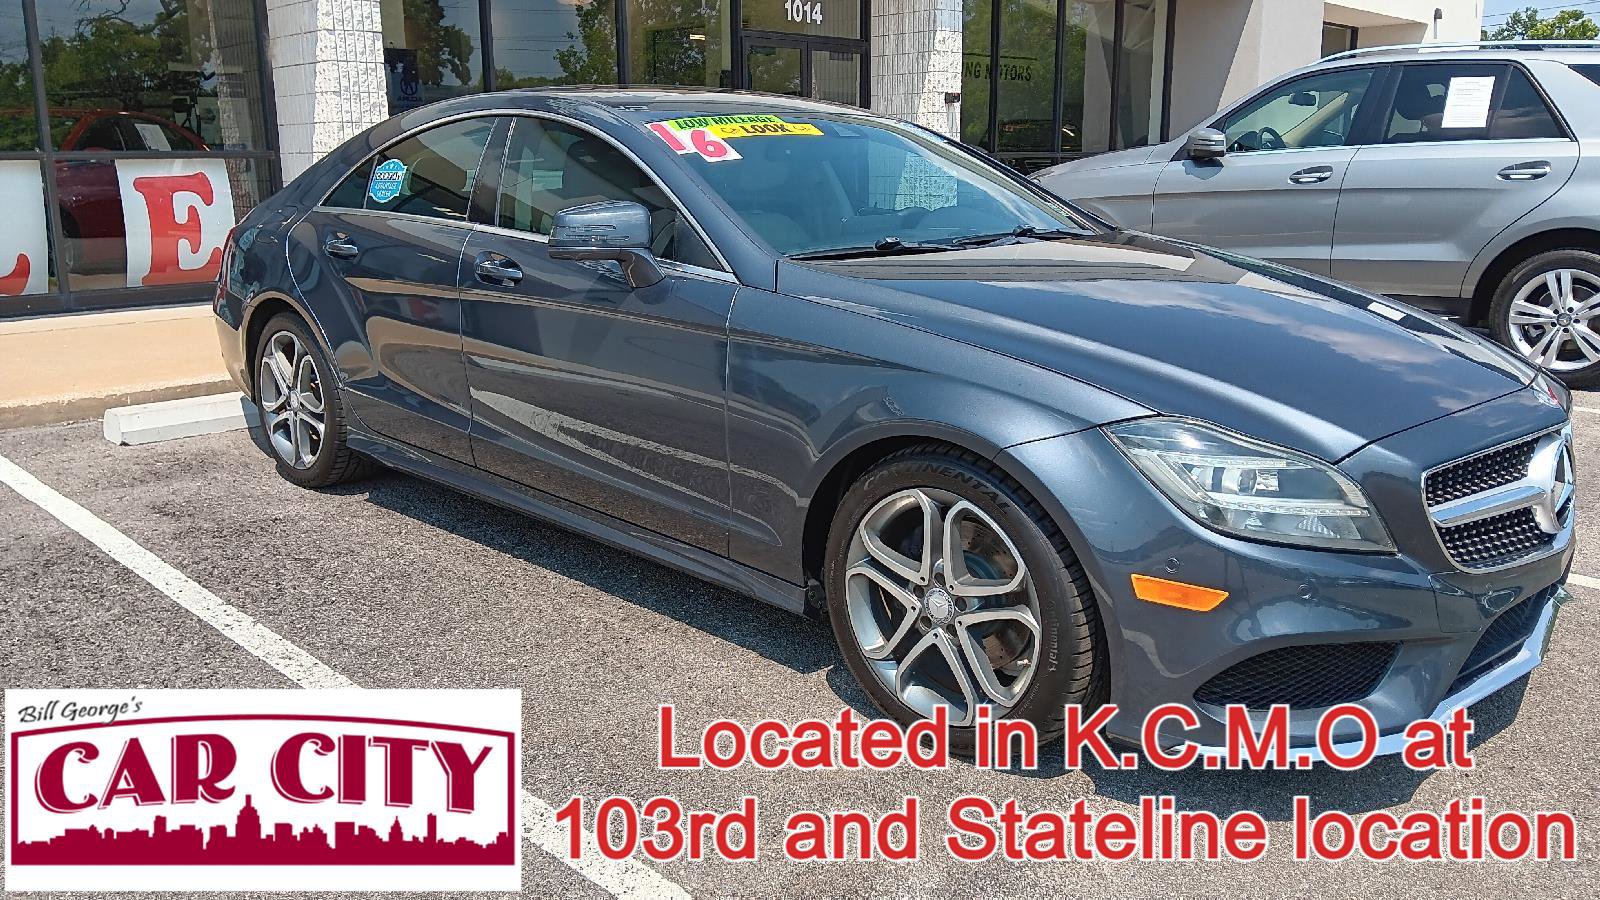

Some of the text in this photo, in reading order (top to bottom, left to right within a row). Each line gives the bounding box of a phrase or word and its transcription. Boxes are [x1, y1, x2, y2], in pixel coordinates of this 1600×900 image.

[784, 0, 822, 24] 1014
[984, 63, 1033, 81] MTORS
[674, 115, 776, 130] LOW MILEAGE
[740, 123, 792, 134] LOOK
[133, 171, 223, 286] E
